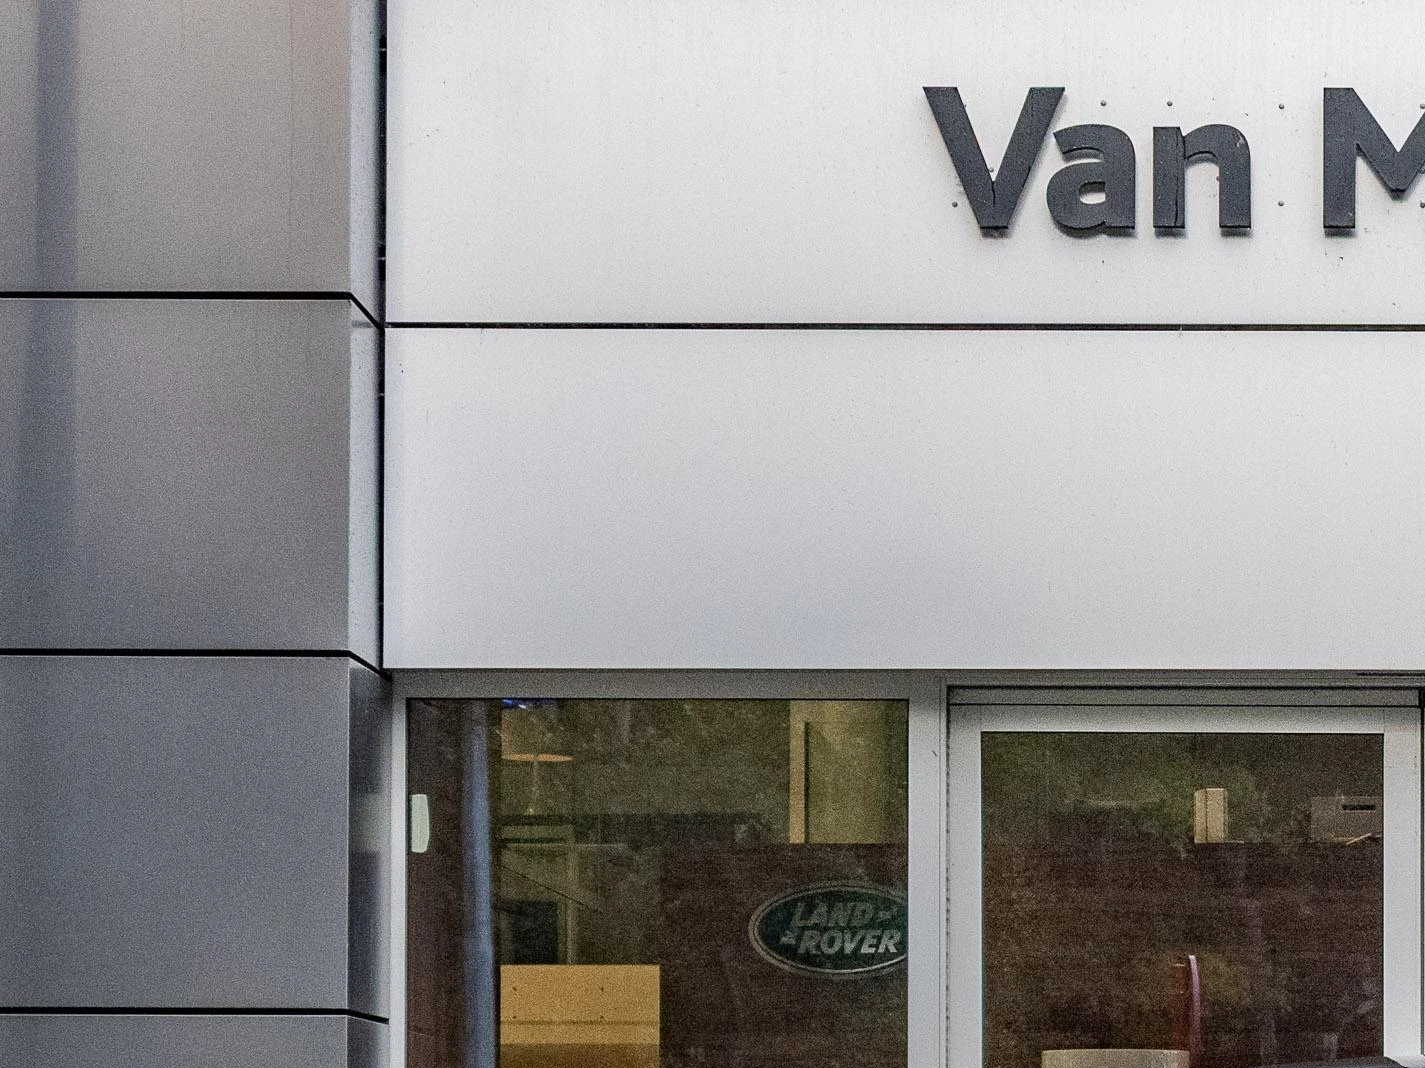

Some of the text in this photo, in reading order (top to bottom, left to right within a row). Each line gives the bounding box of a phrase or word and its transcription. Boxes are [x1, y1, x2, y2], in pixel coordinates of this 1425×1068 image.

[921, 85, 1254, 233] Van
[790, 901, 875, 927] LAND
[798, 929, 902, 954] ROVER
